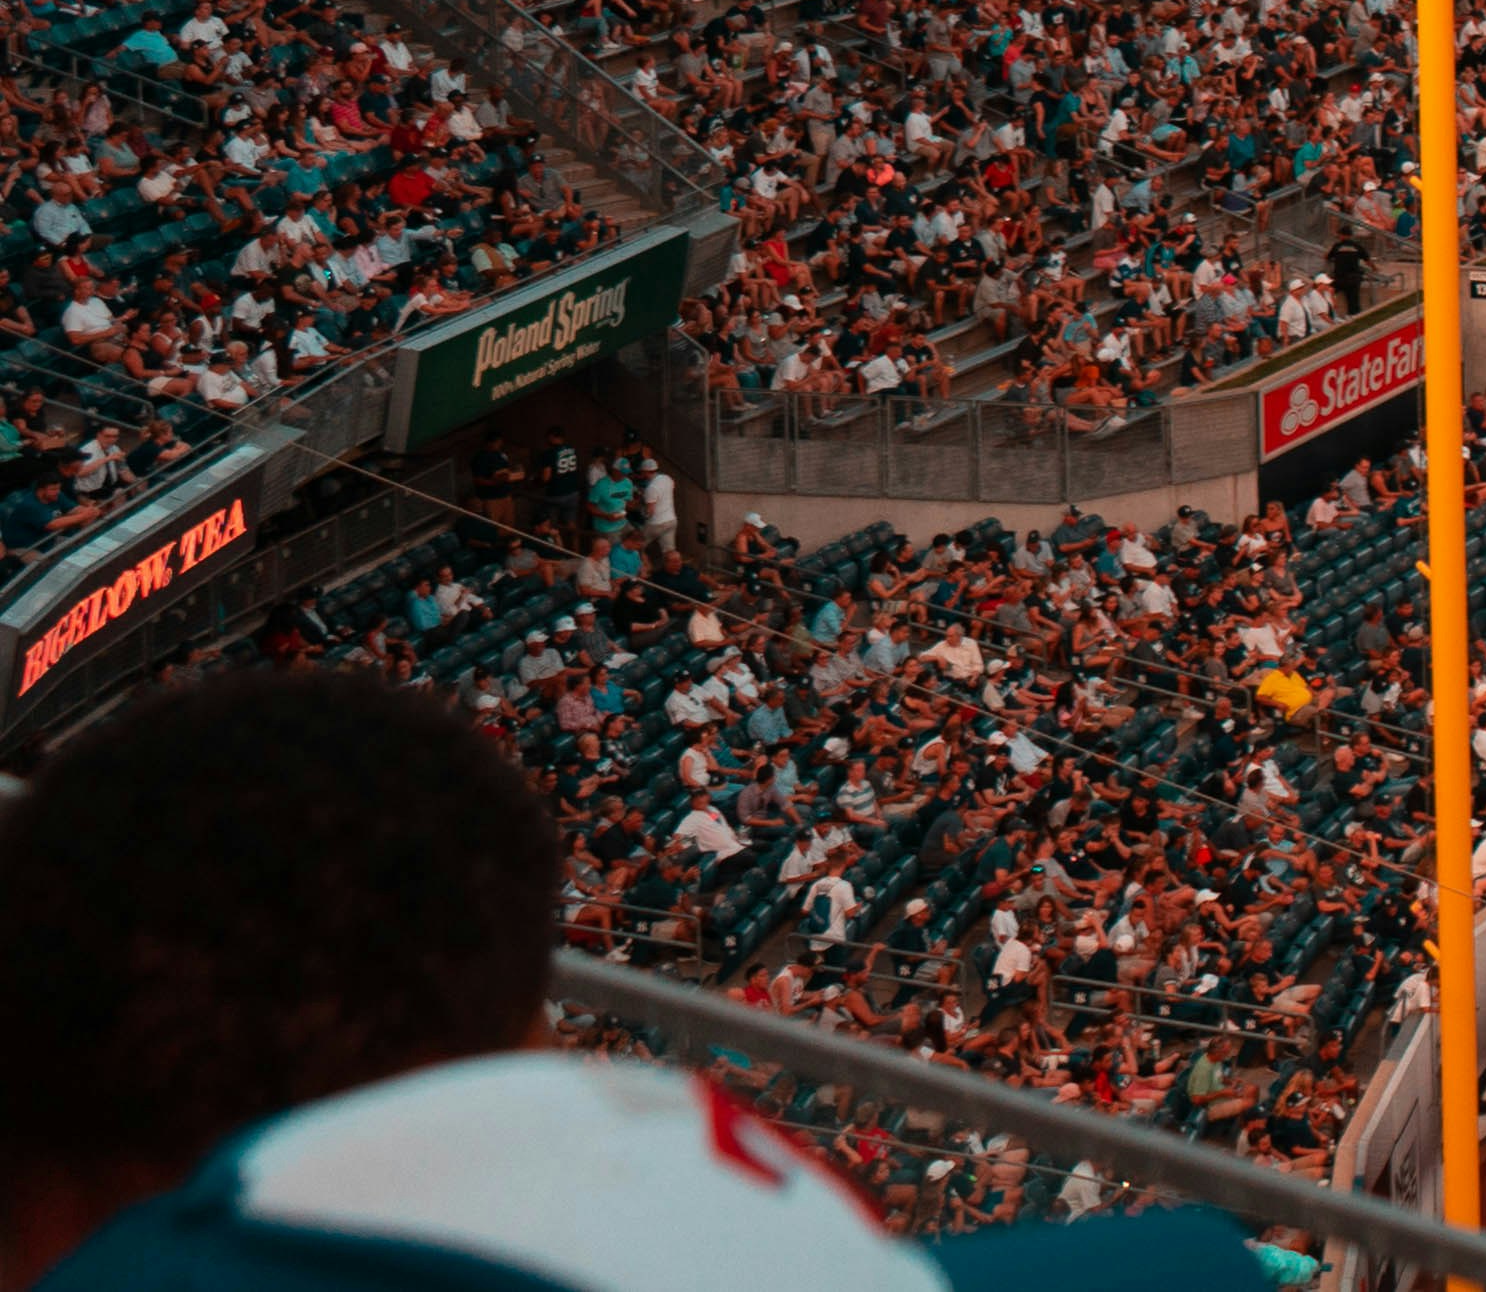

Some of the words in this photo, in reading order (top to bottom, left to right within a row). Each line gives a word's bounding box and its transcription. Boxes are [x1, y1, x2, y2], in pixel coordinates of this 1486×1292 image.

[471, 299, 556, 388] Poland
[553, 276, 632, 351] Spring
[16, 538, 174, 698] BIGELOW
[178, 496, 249, 577] TEA
